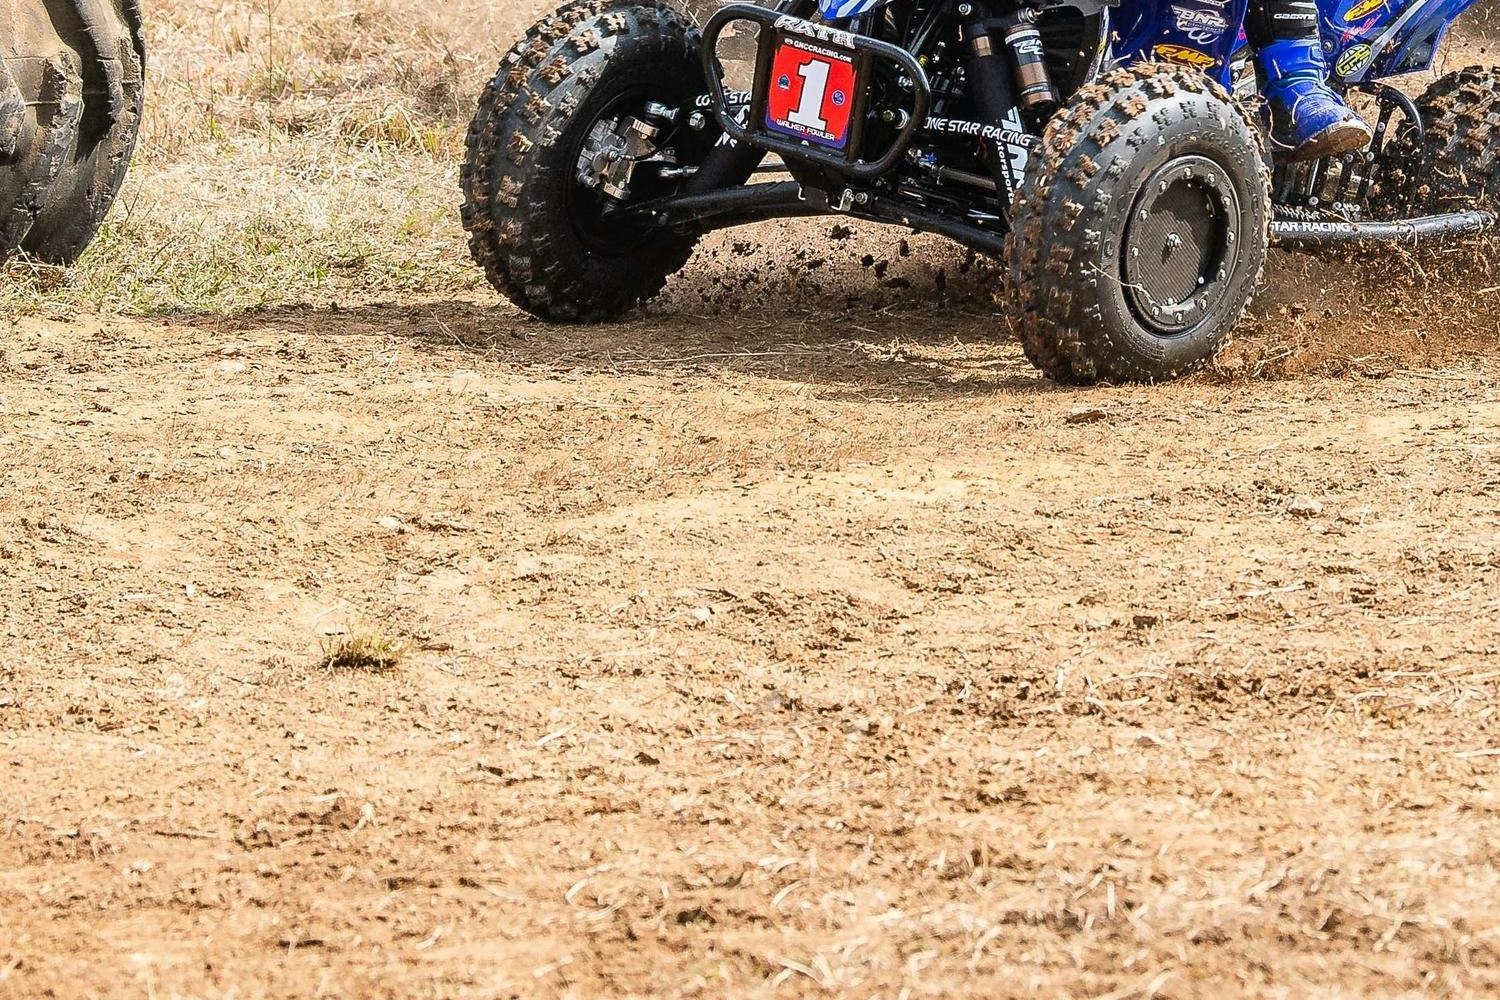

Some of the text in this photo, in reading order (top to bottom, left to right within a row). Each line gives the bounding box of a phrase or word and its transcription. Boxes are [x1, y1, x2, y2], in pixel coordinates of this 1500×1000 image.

[774, 15, 856, 50] RATH
[793, 40, 852, 63] GNCCRACING.com
[729, 91, 753, 104] STA
[788, 58, 831, 132] 1
[776, 118, 836, 142] WALKER FOWLER
[948, 119, 982, 136] STAR
[982, 124, 1034, 146] RACING
[1302, 222, 1351, 232] RACING
